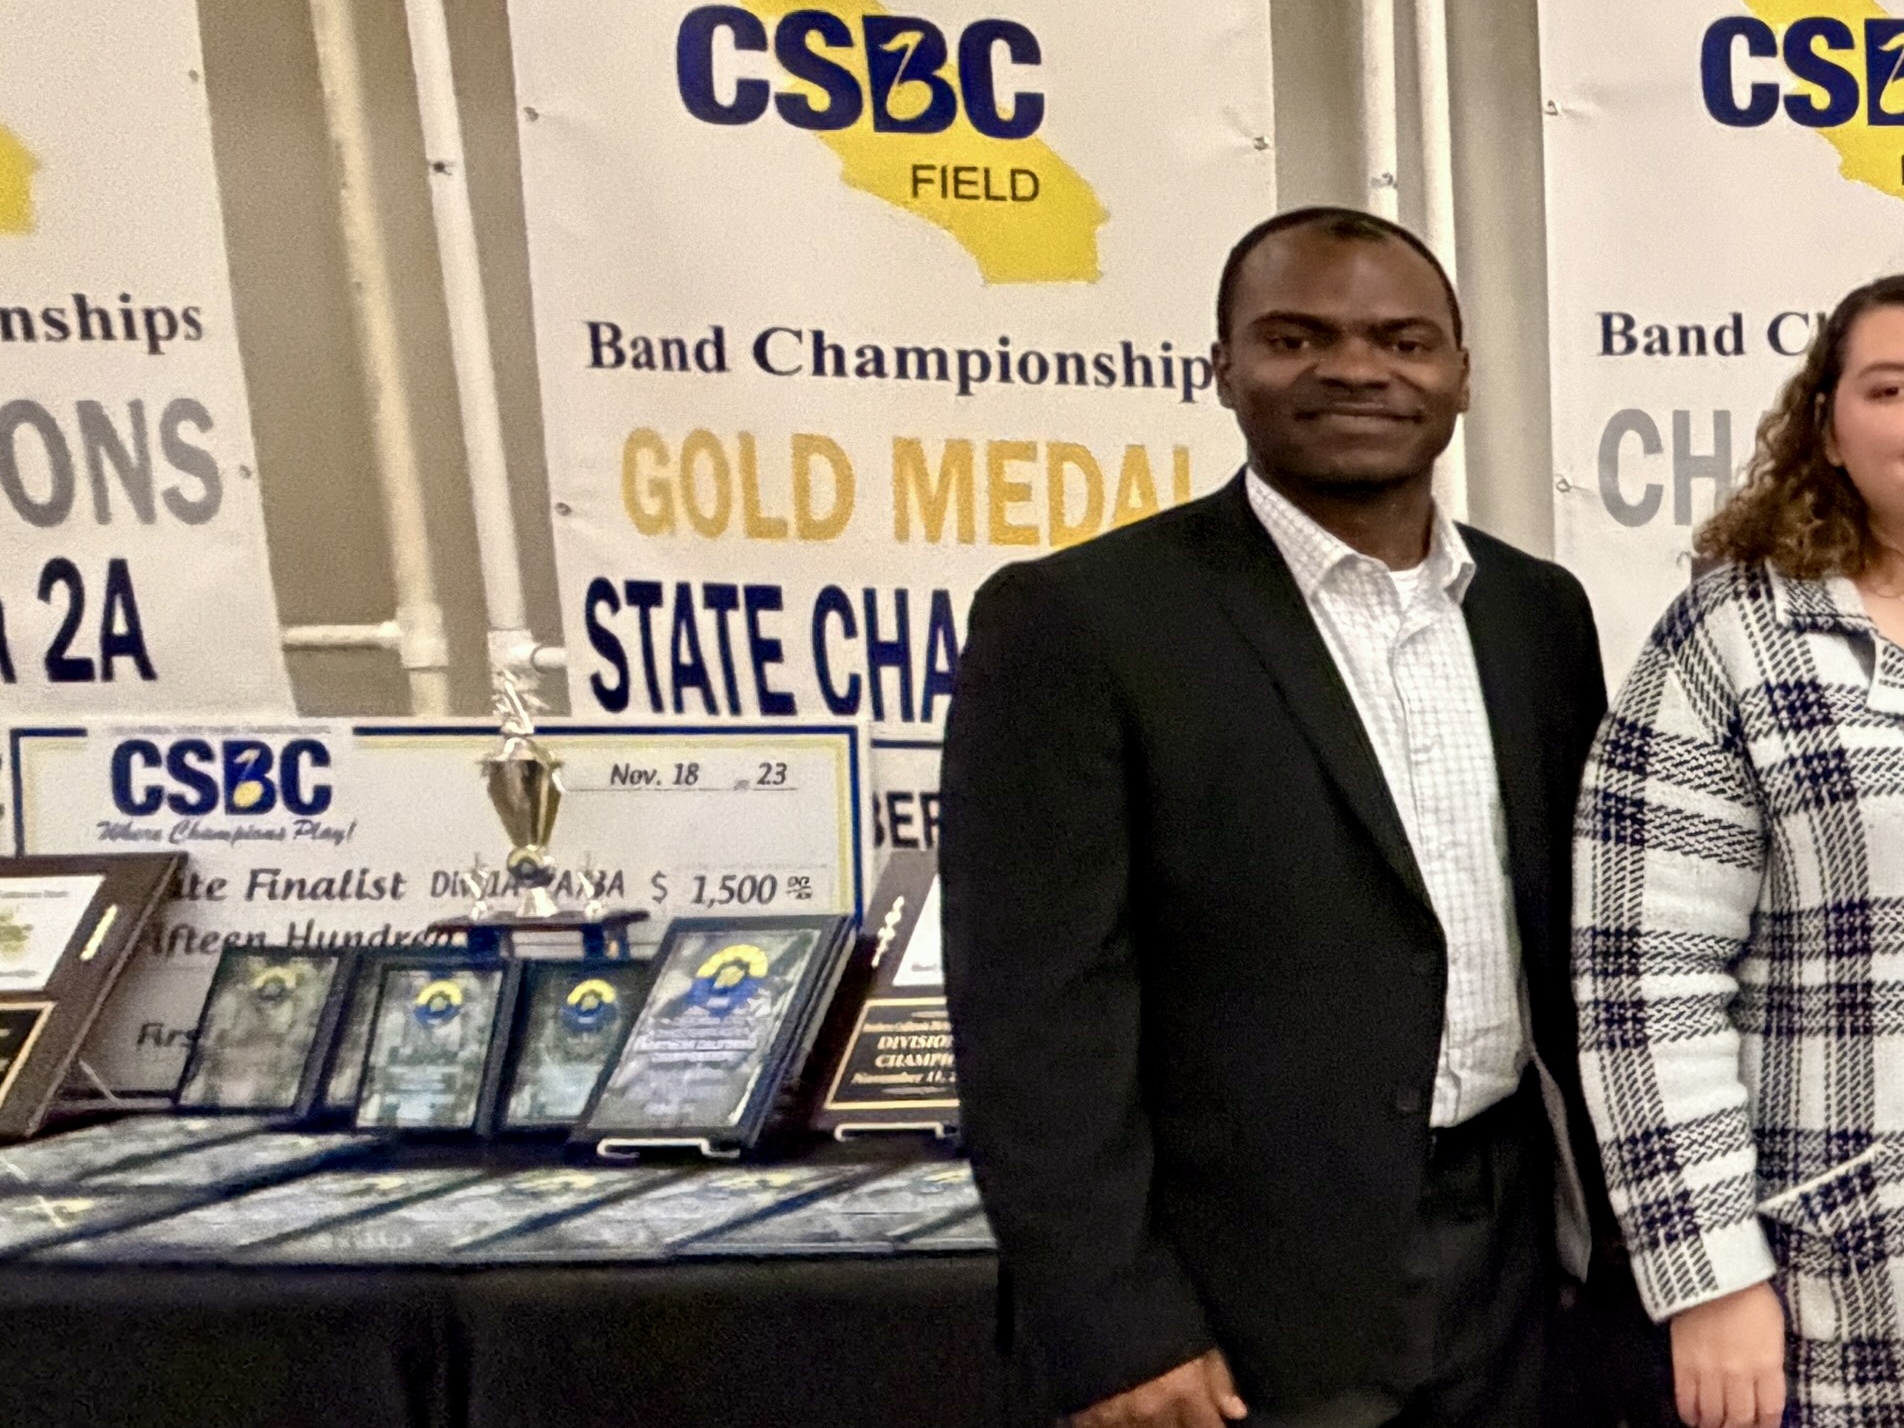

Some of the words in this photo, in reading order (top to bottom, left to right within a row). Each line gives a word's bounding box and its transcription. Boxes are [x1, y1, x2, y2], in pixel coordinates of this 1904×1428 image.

[675, 3, 1046, 141] CSBC
[910, 164, 1041, 204] FIELD
[584, 321, 730, 375] Band
[751, 326, 1214, 403] Championship
[1596, 310, 1745, 358] Band
[620, 427, 857, 543] GOLD
[38, 556, 158, 683] 2A
[584, 575, 797, 717] STATE
[110, 738, 333, 817] CSBC
[609, 762, 664, 788] Nov.
[672, 762, 700, 786] 18
[756, 762, 788, 786] 23
[168, 820, 287, 849] Champions
[244, 867, 408, 902] Finalist
[651, 870, 669, 904] $
[690, 873, 778, 908] 1,500
